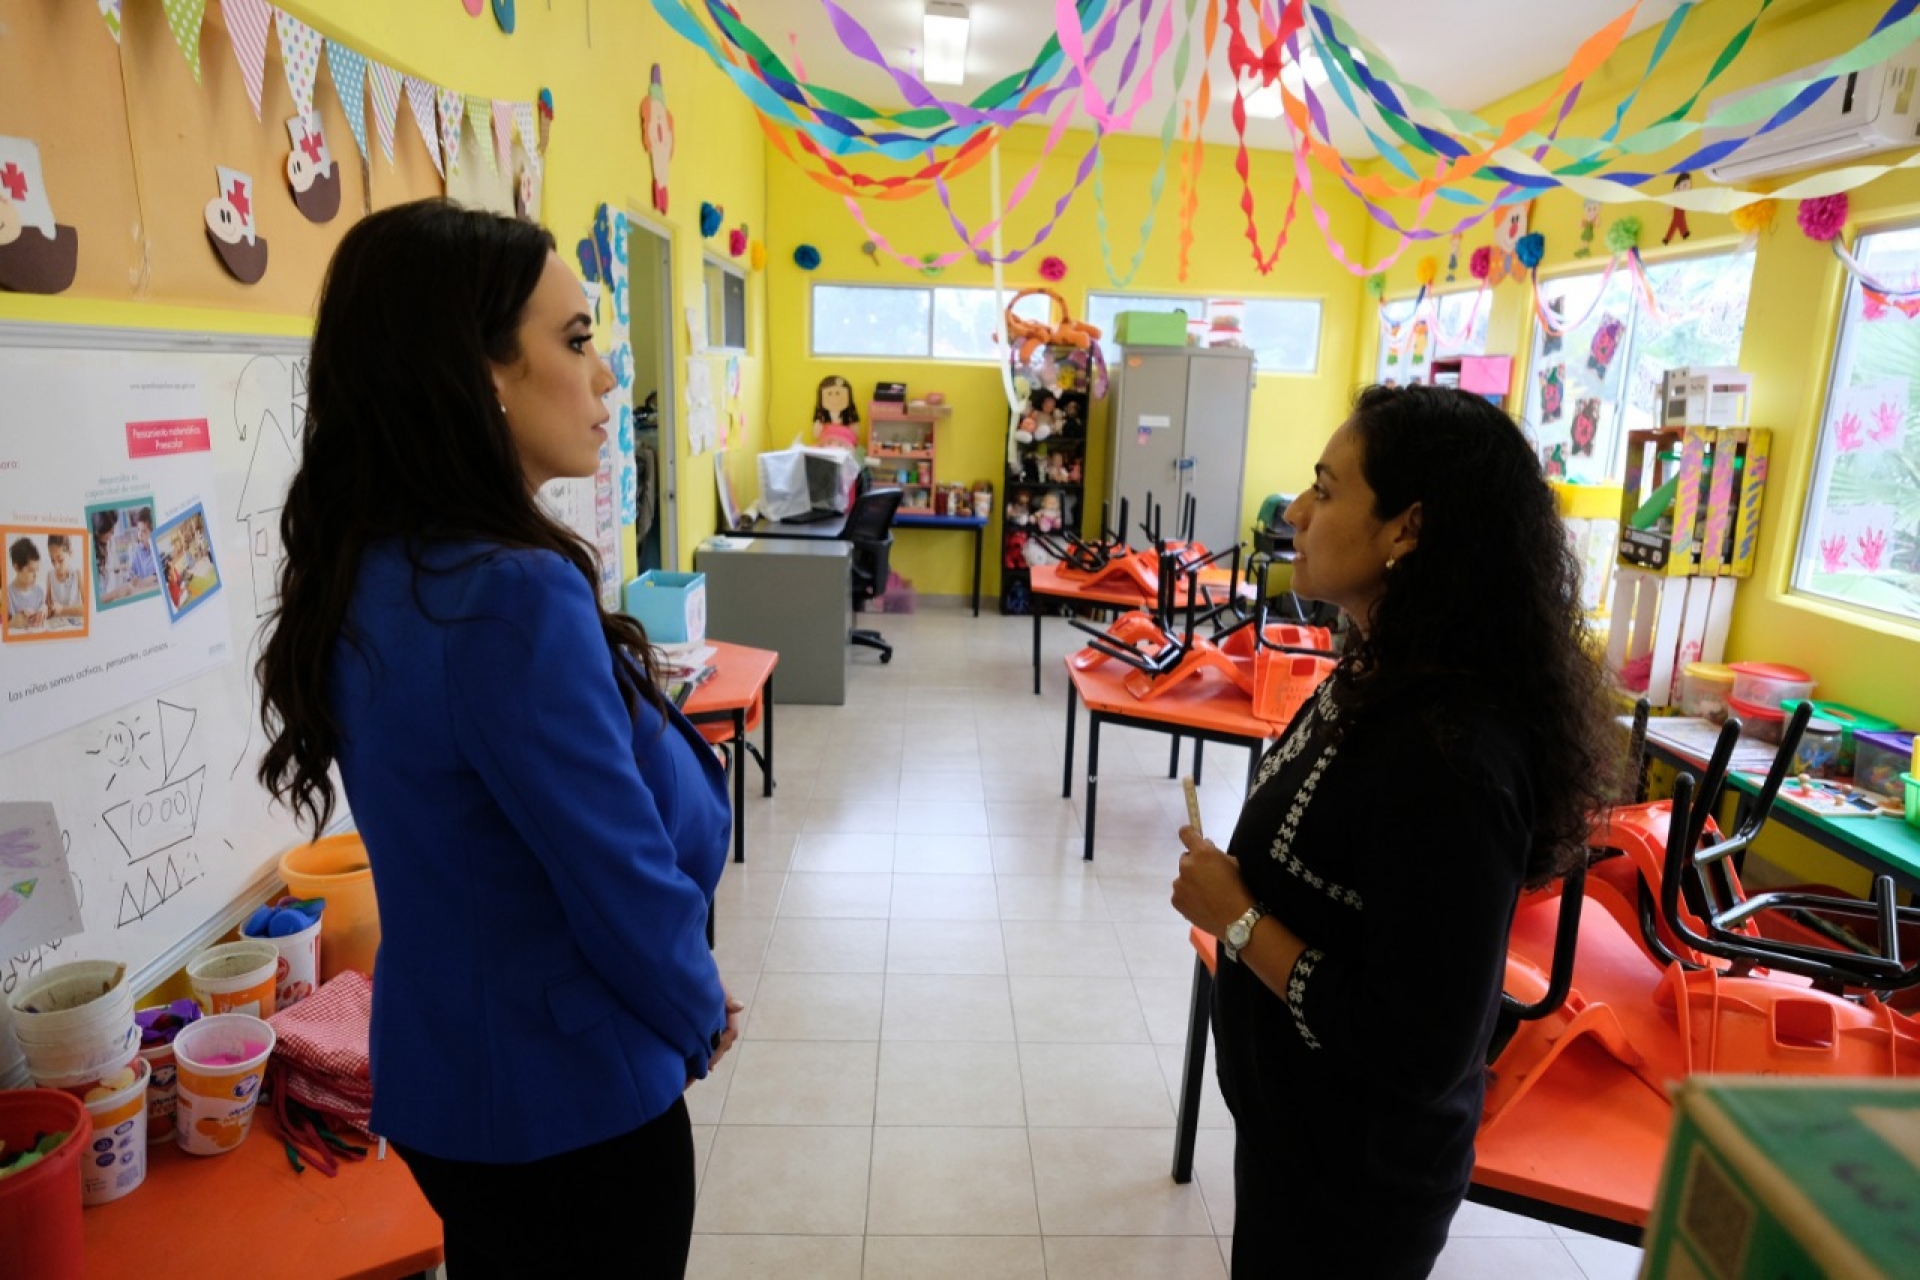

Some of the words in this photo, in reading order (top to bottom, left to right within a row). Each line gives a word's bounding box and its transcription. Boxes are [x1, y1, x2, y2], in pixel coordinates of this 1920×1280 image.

[0, 459, 20, 470] ara:
[9, 690, 23, 702] Los
[25, 683, 48, 697] niños
[49, 673, 75, 688] somos
